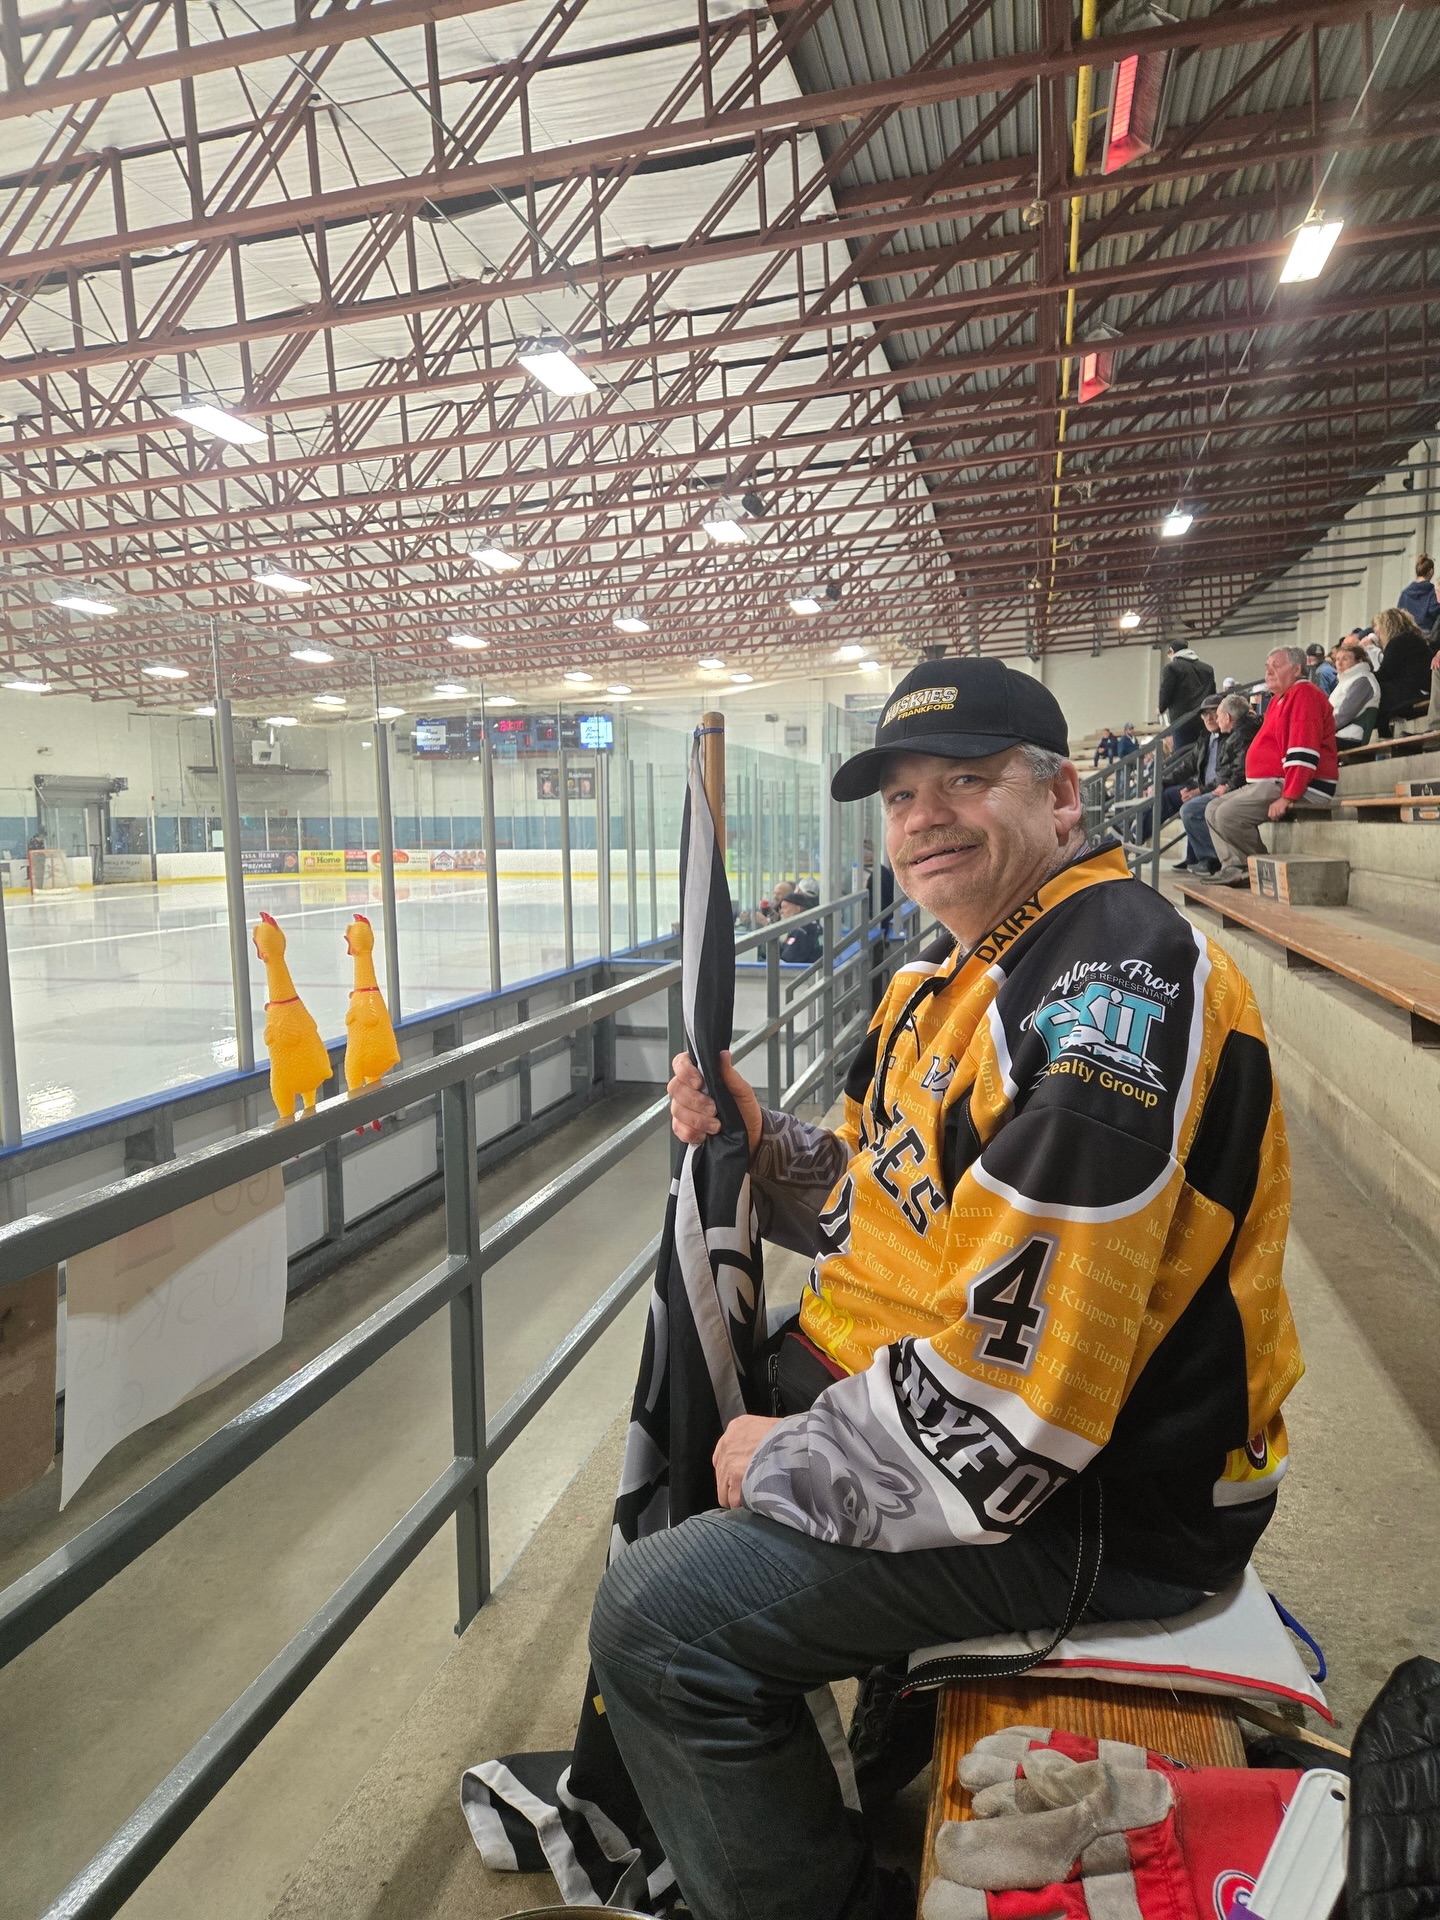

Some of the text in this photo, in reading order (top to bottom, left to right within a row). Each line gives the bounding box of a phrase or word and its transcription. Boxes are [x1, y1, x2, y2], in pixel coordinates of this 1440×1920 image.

[881, 687, 958, 728] HUSKIES
[898, 703, 954, 720] FRANKFORD
[974, 894, 1044, 964] DAIRY
[1099, 973, 1175, 1008] REPRESENTATIVE
[1120, 959, 1180, 998] Frost
[1099, 1071, 1158, 1108] Group
[851, 1213, 934, 1273] ntoine-Boucher
[864, 1252, 895, 1281] Koren
[896, 1274, 919, 1301] Van
[1068, 1252, 1128, 1294] Klaiber
[802, 1307, 823, 1332] Sage
[967, 1233, 1055, 1370] 4
[1058, 1285, 1118, 1328] Kuipers
[1050, 1319, 1091, 1354] Bales
[971, 1361, 1032, 1394] Adams
[1048, 1358, 1112, 1402] Hubbard
[1063, 1406, 1112, 1442] Franks
